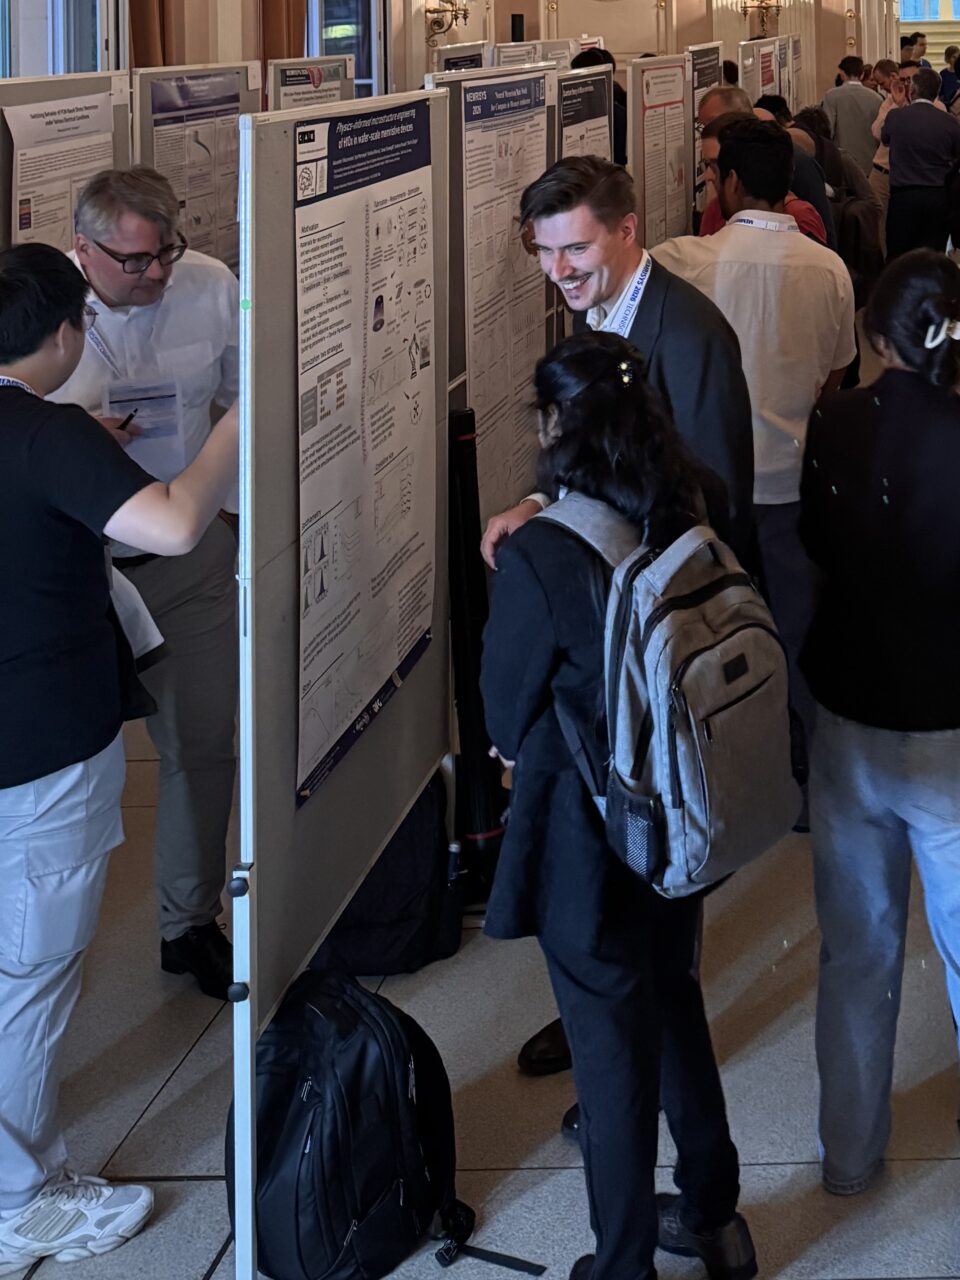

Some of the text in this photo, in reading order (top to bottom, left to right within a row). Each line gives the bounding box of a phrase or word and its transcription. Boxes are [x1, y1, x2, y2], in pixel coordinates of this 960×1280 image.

[336, 118, 370, 135] Physics-informed
[338, 136, 344, 149] of
[358, 129, 380, 144] wafer-scale
[400, 122, 413, 133] devices
[301, 222, 319, 233] Motivation
[637, 257, 652, 288] EMRISYS
[630, 286, 641, 302] 2026
